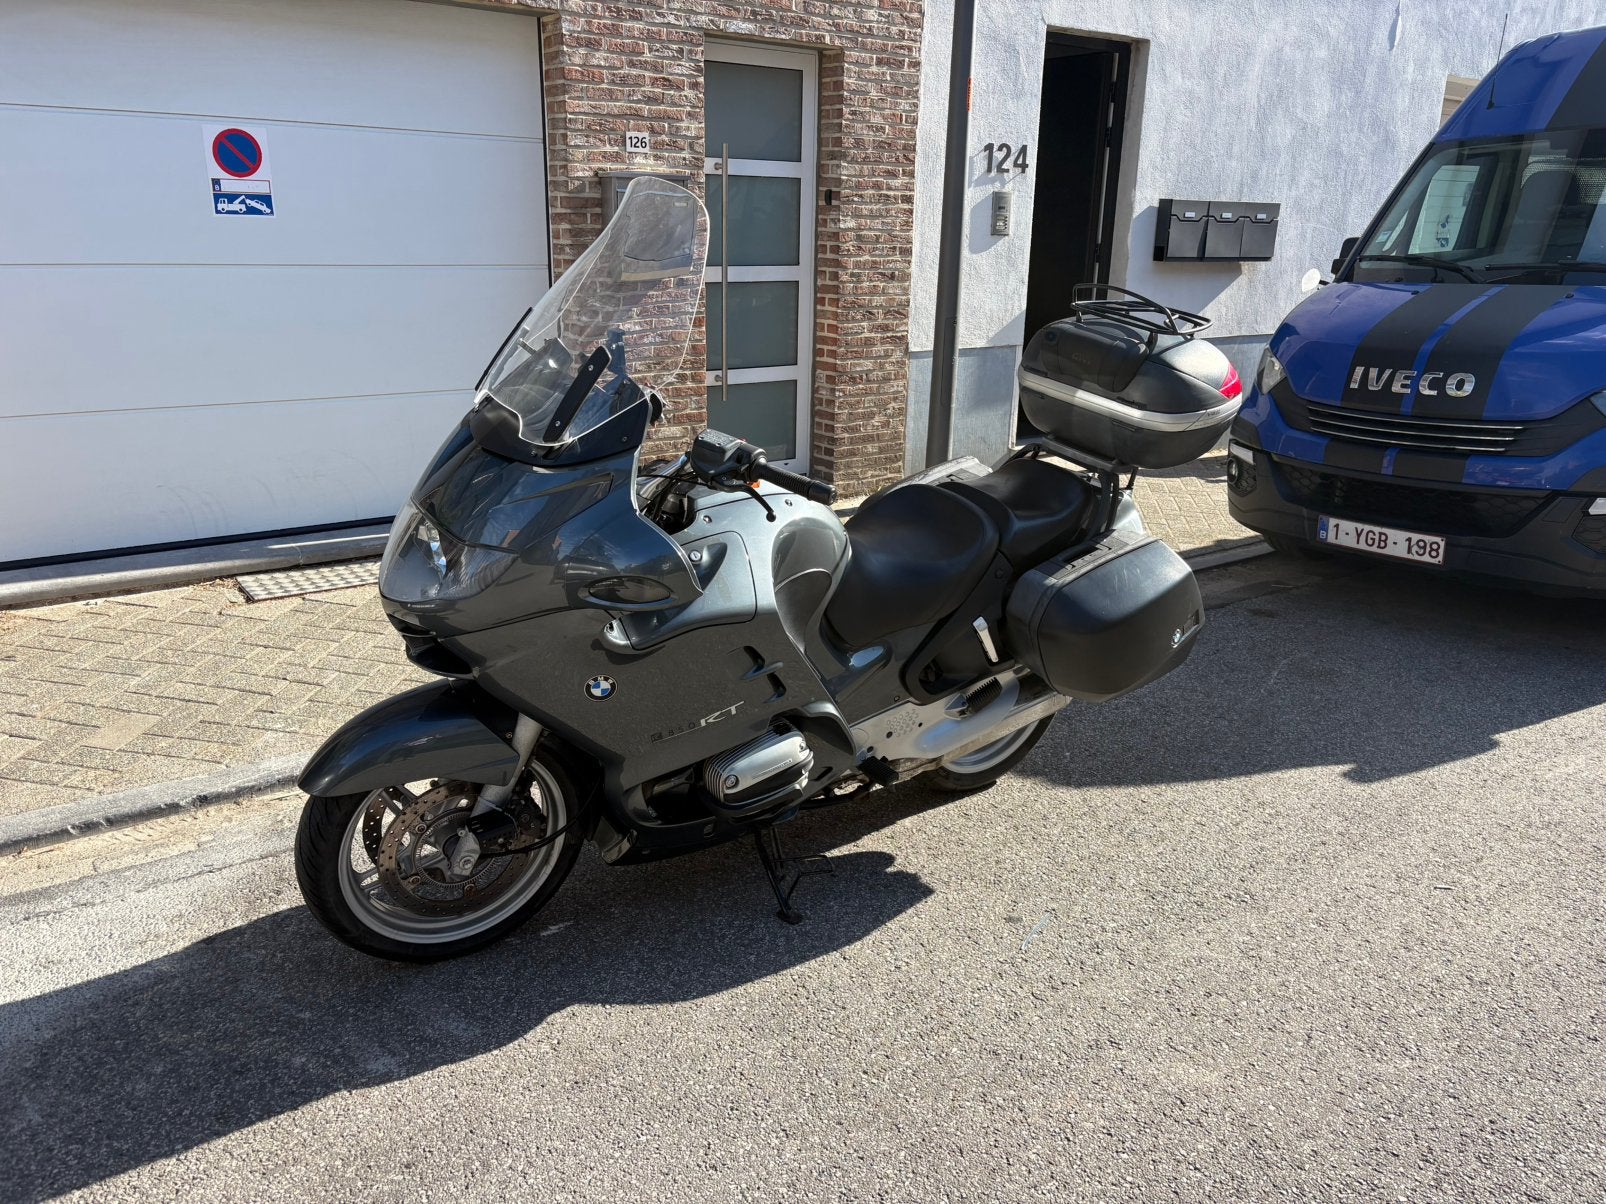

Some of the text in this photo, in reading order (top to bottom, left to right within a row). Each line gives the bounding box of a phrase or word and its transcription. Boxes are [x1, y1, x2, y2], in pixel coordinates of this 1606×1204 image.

[628, 136, 647, 149] 126
[983, 142, 1029, 174] 124
[1350, 366, 1476, 398] IVECO
